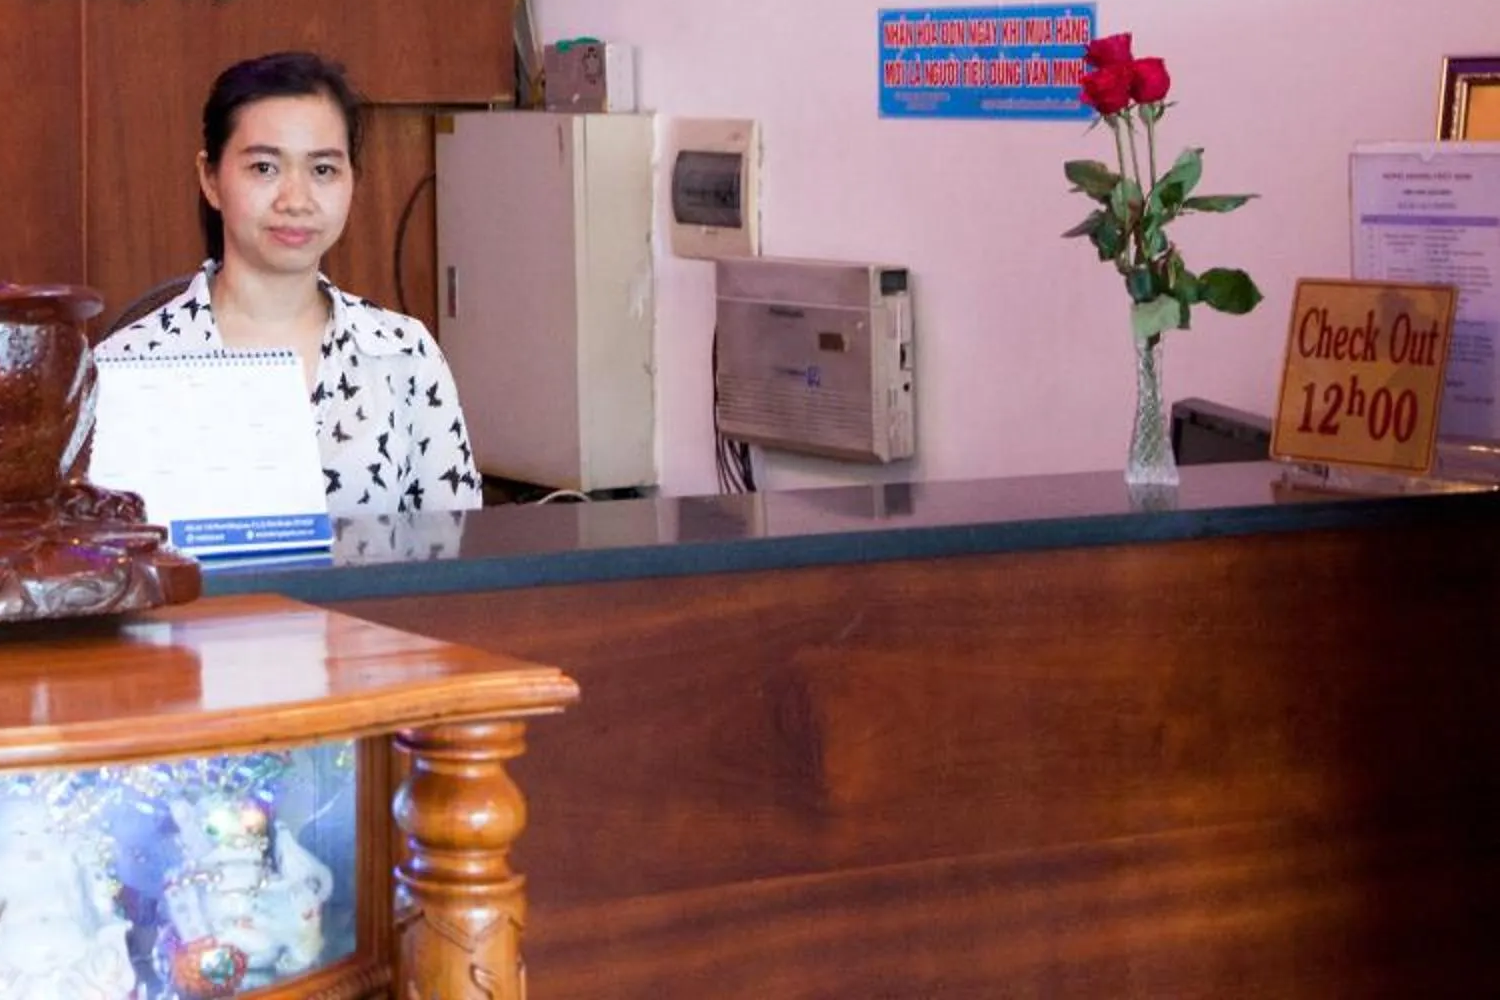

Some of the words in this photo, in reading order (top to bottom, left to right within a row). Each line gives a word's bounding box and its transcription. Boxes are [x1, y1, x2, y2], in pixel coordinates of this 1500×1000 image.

[1001, 17, 1022, 46] KHI
[1052, 59, 1086, 87] MINH
[1298, 307, 1380, 362] Check
[1390, 312, 1440, 366] Out
[1297, 375, 1419, 443] 12h00
